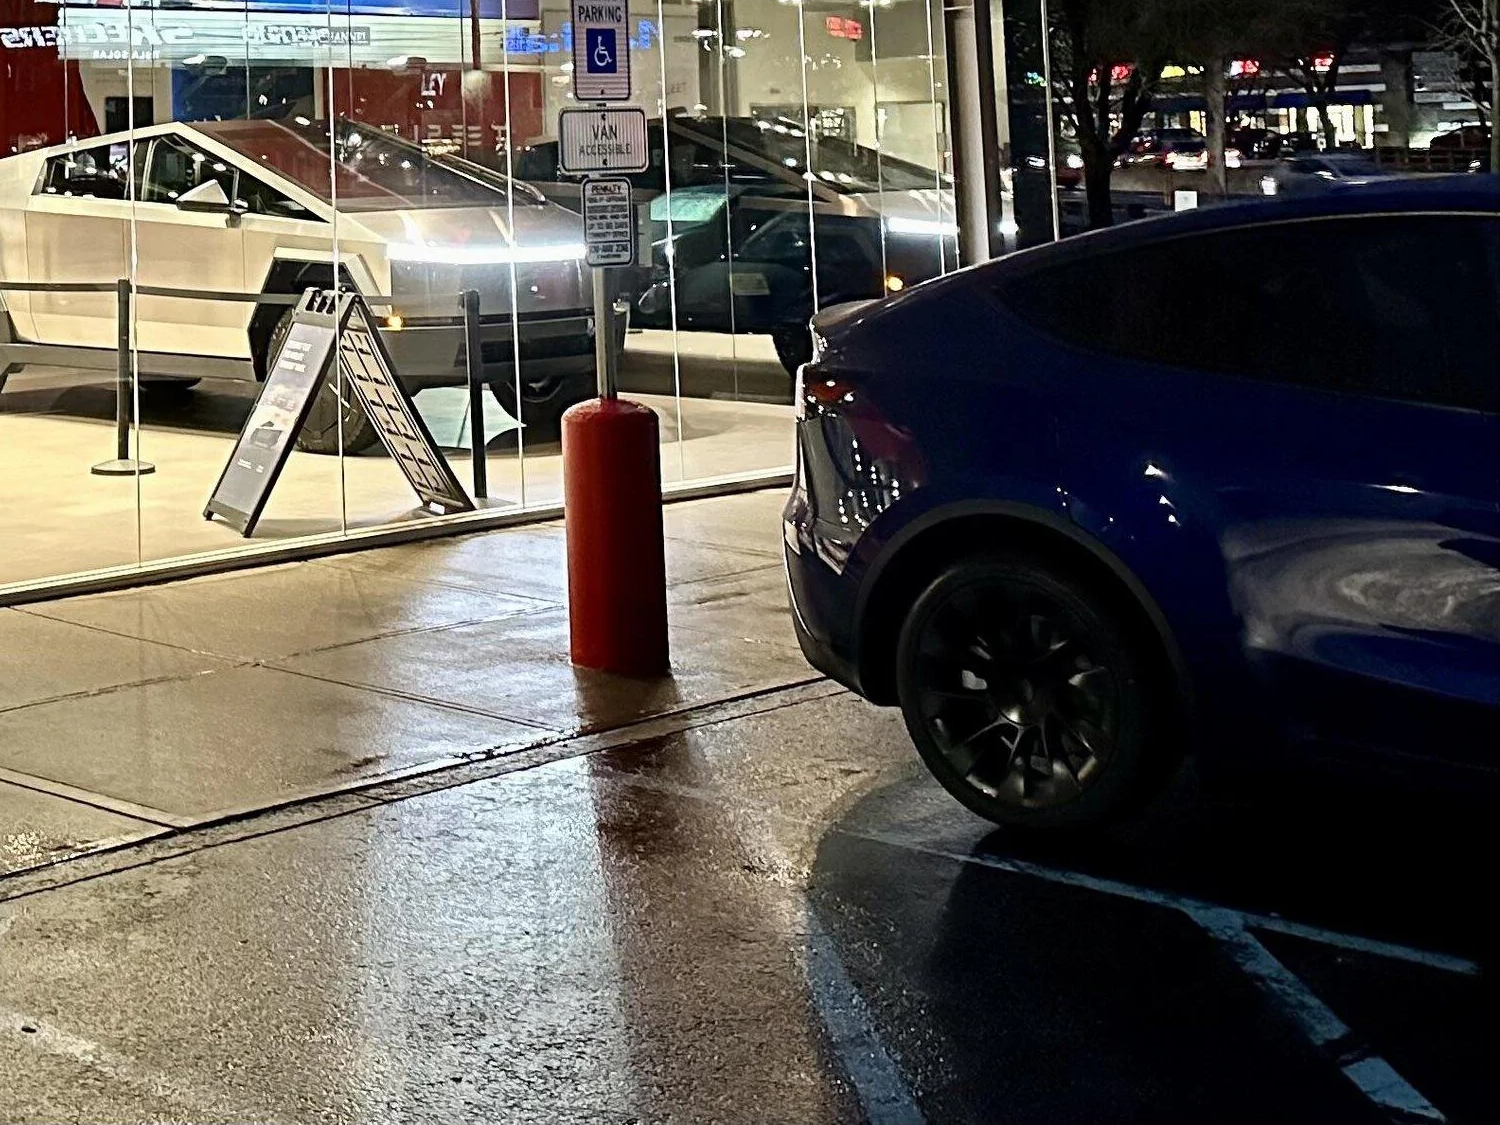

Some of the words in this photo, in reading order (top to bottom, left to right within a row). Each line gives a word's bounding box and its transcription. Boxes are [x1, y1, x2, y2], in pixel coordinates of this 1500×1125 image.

[578, 5, 623, 23] PARKING
[591, 124, 618, 141] VAN
[578, 143, 632, 157] ACCESSIBLE
